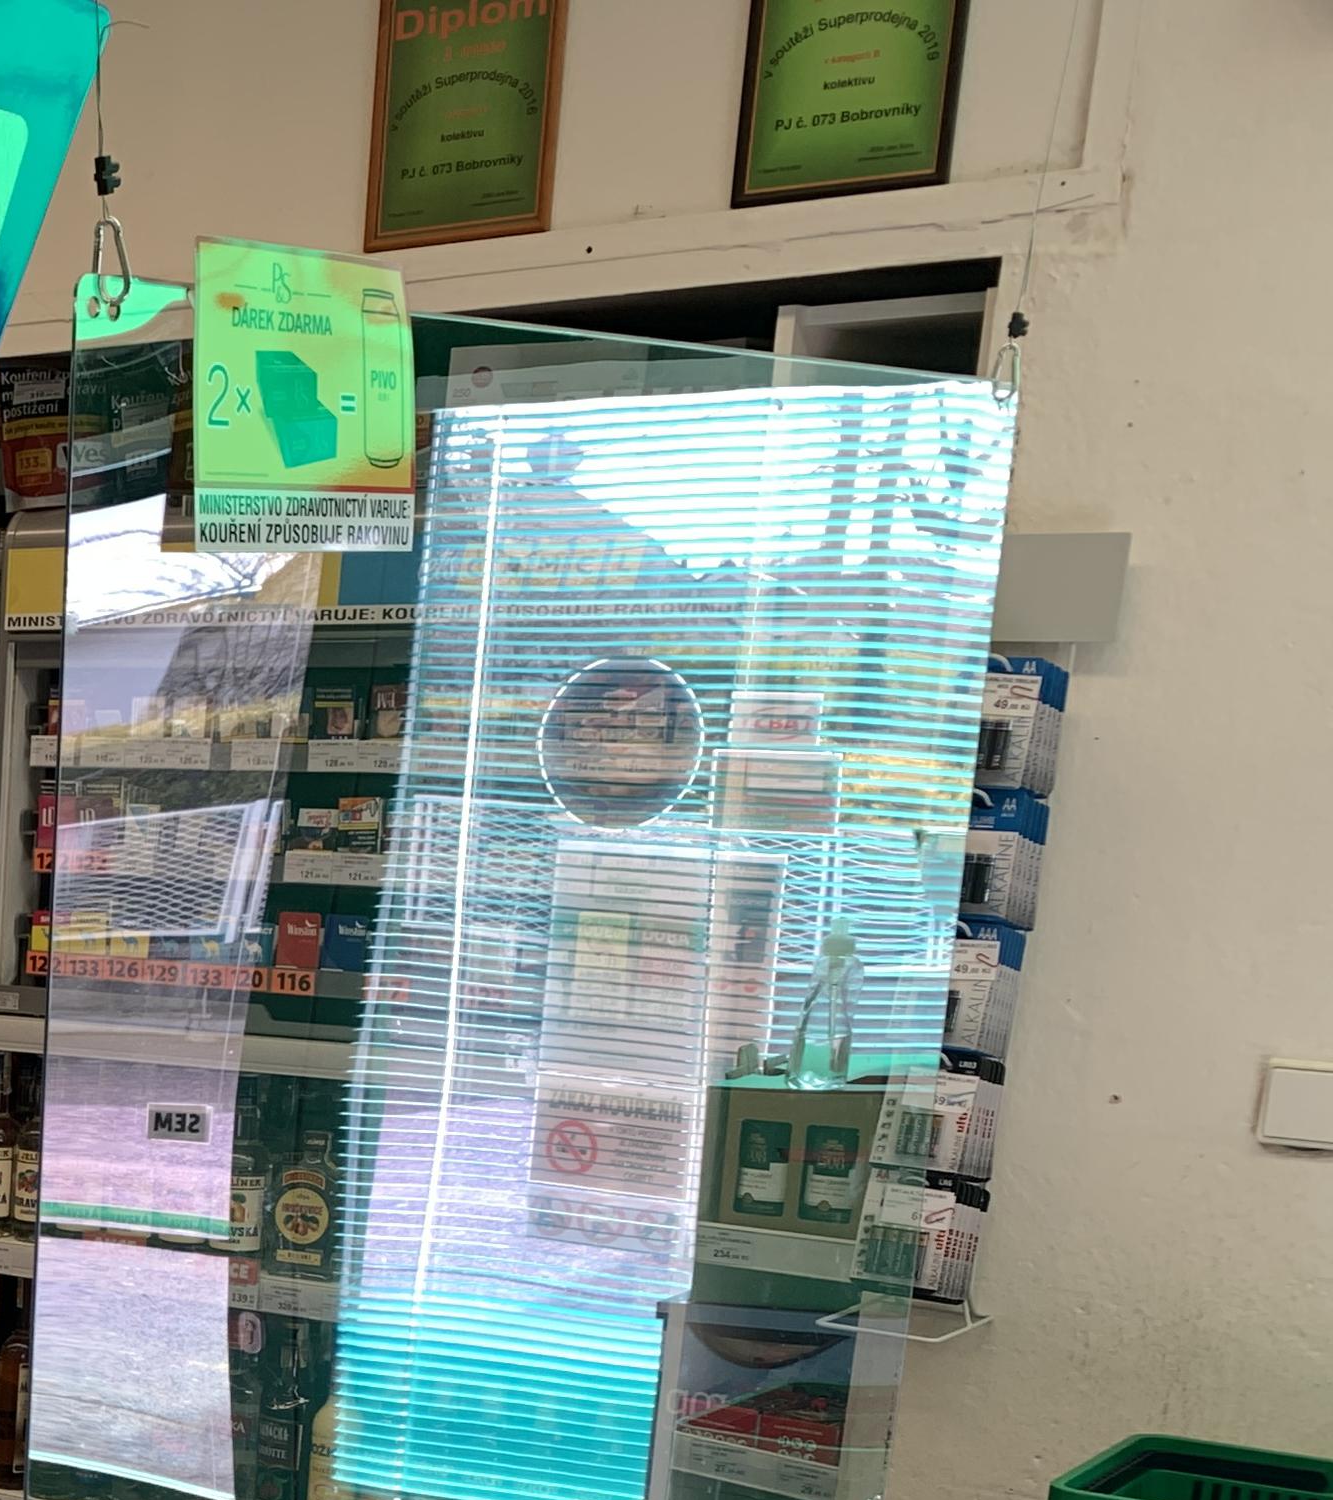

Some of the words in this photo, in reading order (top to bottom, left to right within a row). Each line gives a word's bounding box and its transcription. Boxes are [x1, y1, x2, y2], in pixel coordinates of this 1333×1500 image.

[818, 9, 919, 32] Superprodejna
[435, 70, 520, 90] Superprodejna
[823, 75, 875, 91] kolektivu
[774, 118, 793, 132] PJ
[812, 113, 836, 127] 073
[440, 128, 485, 143] kolektivu
[432, 161, 453, 175] 073
[232, 306, 275, 331] DÁREK
[277, 310, 332, 336] ZDARMA
[370, 370, 397, 391] PIVO
[199, 494, 282, 518] MINISTERSTVO
[285, 493, 368, 518] ZDRAVOTNICTVÍ
[370, 498, 411, 520] VARUJE:
[199, 516, 263, 545] KOUŘENÍ
[266, 517, 343, 546] ZPŮSOBUJE
[347, 524, 409, 547] RAKOVINU
[989, 834, 1016, 913] ALKALINE
[978, 927, 998, 940] AAA
[68, 959, 99, 977] 133
[107, 961, 139, 979] 126
[146, 964, 178, 982] 129
[189, 968, 223, 987] 133
[276, 972, 311, 992] 116
